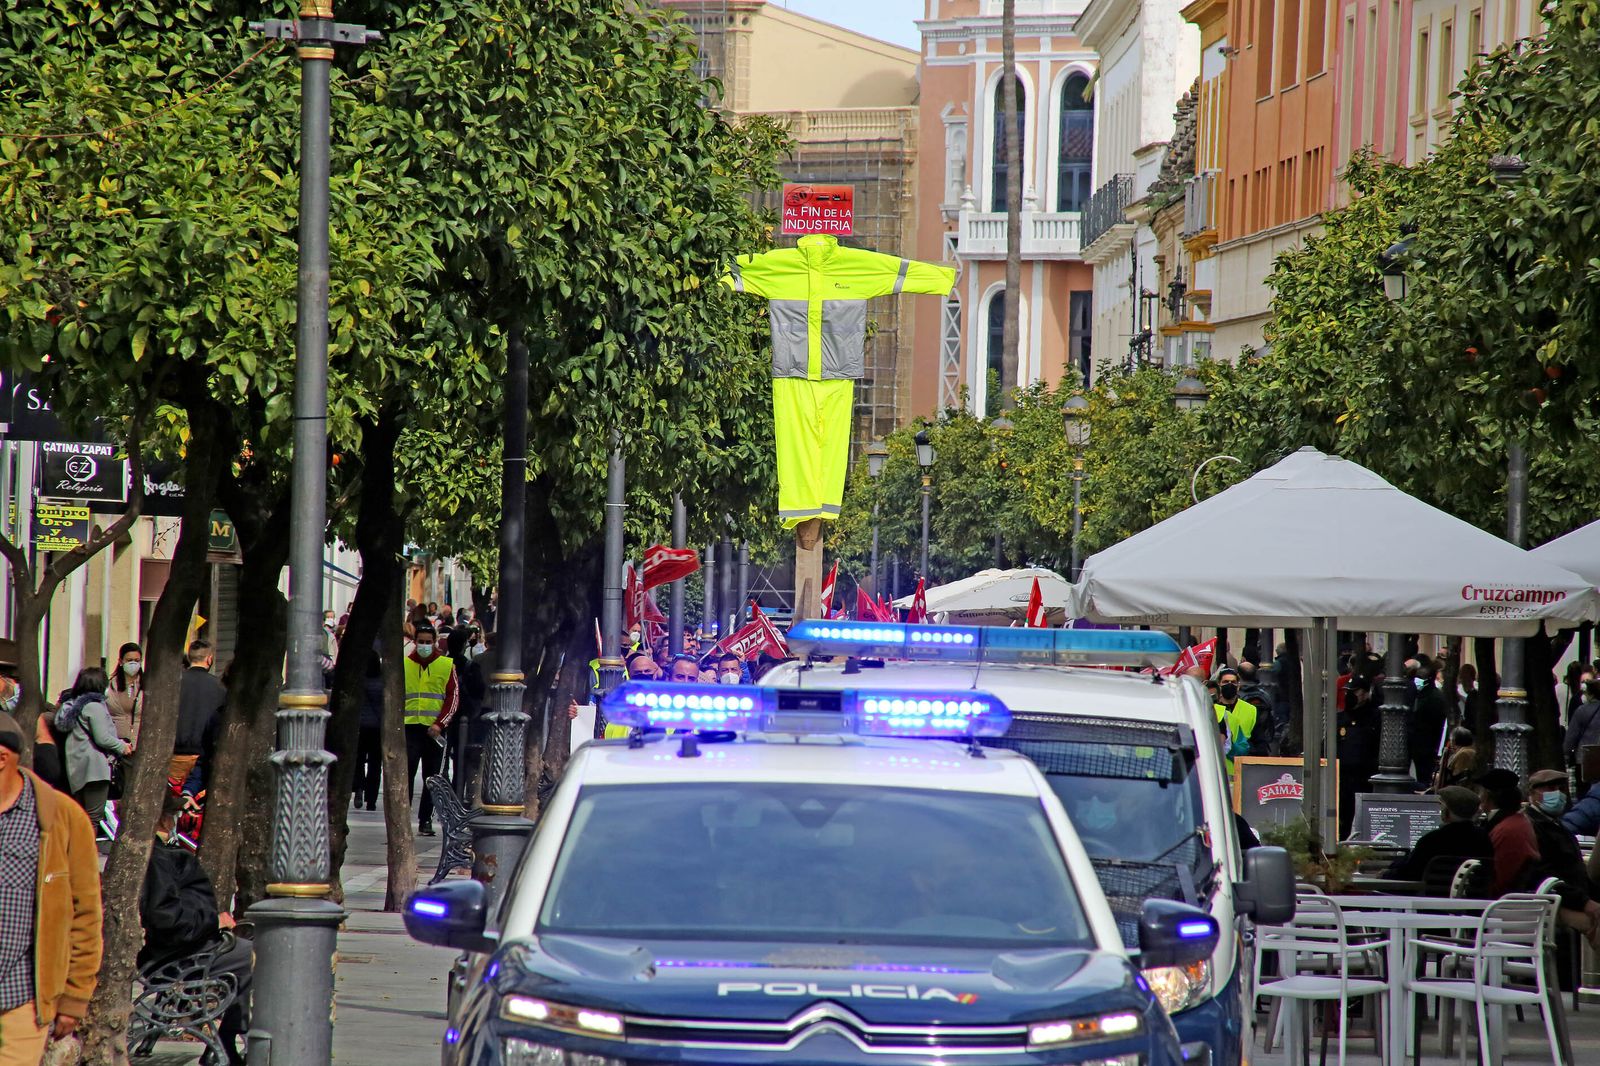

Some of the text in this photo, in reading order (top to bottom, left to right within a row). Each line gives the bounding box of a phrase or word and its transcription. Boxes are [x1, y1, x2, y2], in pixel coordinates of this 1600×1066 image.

[785, 206, 852, 218] AL FIN DE LA
[785, 219, 851, 230] INDUSTRIA
[43, 441, 112, 456] CATINA ZAPAT
[37, 508, 87, 517] ompro
[40, 518, 74, 527] Oro
[210, 520, 230, 537] M
[50, 528, 61, 536] y
[1461, 583, 1566, 606] Cruzcampo
[1261, 784, 1305, 798] SAIMAZ
